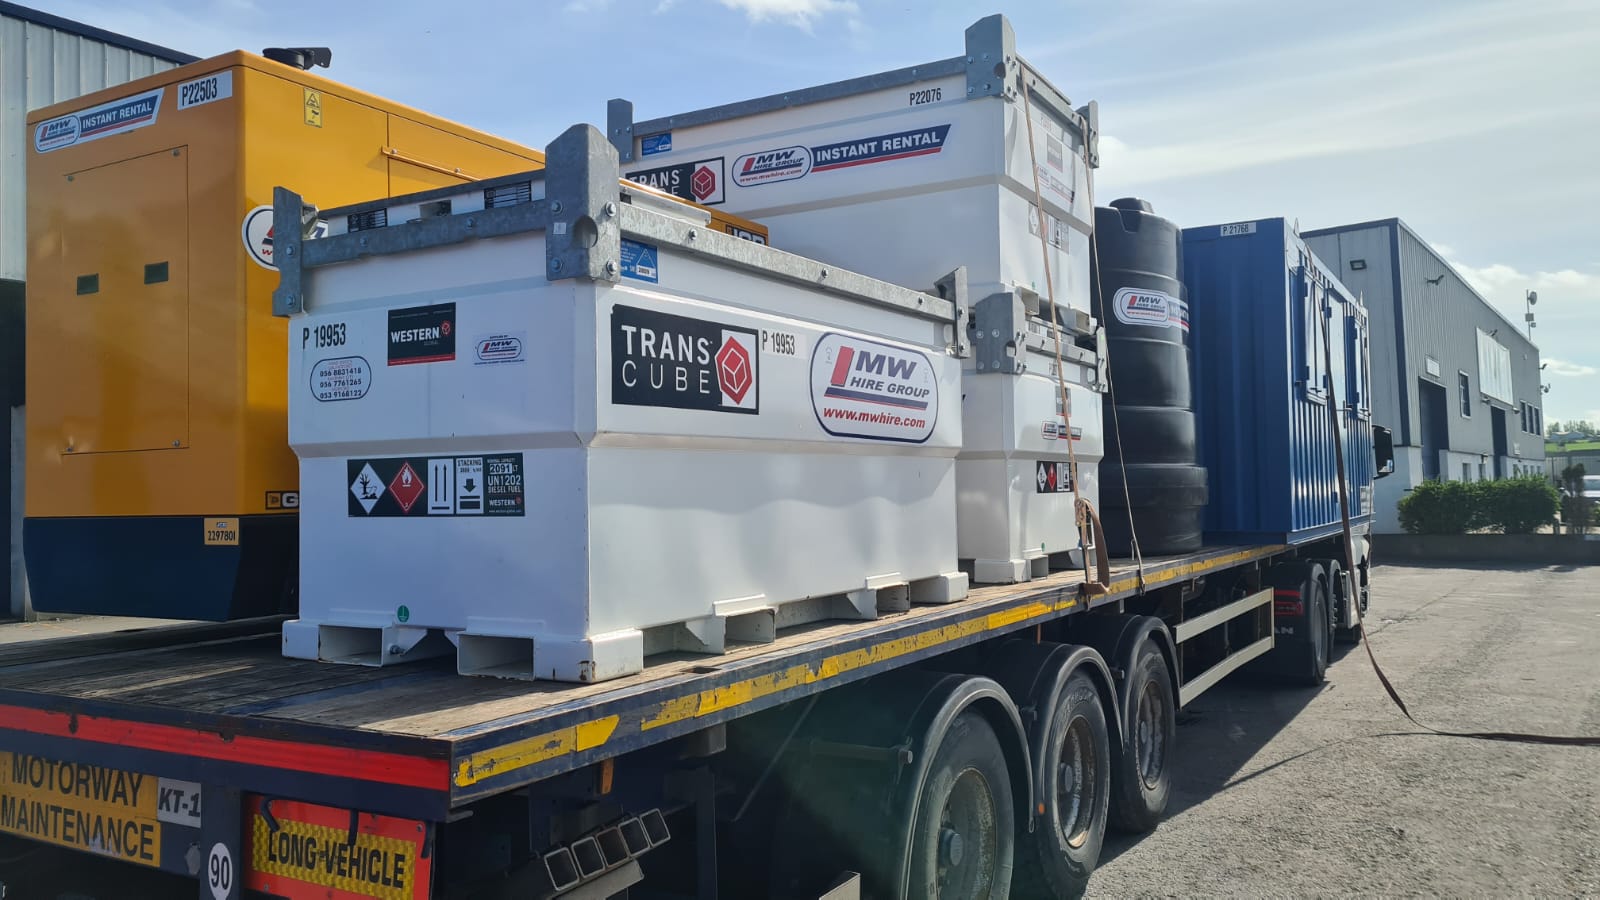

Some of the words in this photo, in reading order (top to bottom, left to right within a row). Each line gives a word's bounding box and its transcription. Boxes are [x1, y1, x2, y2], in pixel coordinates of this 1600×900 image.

[182, 78, 217, 106] P22503
[909, 88, 942, 106] P22076
[48, 119, 71, 132] MW
[82, 111, 117, 129] INSTANT
[119, 101, 152, 120] RENTAL
[756, 150, 796, 164] MW
[816, 142, 877, 162] INSTANT
[881, 131, 941, 151] RENTAL
[1138, 296, 1161, 304] MW
[303, 328, 310, 349] P
[314, 323, 346, 348] 19953
[391, 327, 440, 343] WESTERN
[621, 324, 710, 366] TRANS
[762, 330, 768, 351] P
[771, 332, 795, 355] 19953
[622, 360, 710, 394] CUBE
[855, 350, 917, 380] MW
[850, 376, 884, 391] HIRE
[887, 382, 930, 398] GROUP
[823, 407, 926, 429] www.mwhire.com
[490, 464, 510, 473] 2091
[12, 754, 142, 807] MOTORWAY
[0, 795, 154, 861] MAINTENANCE
[211, 854, 230, 890] 90
[268, 831, 317, 870] LONG
[325, 840, 406, 889] VEHICLE
